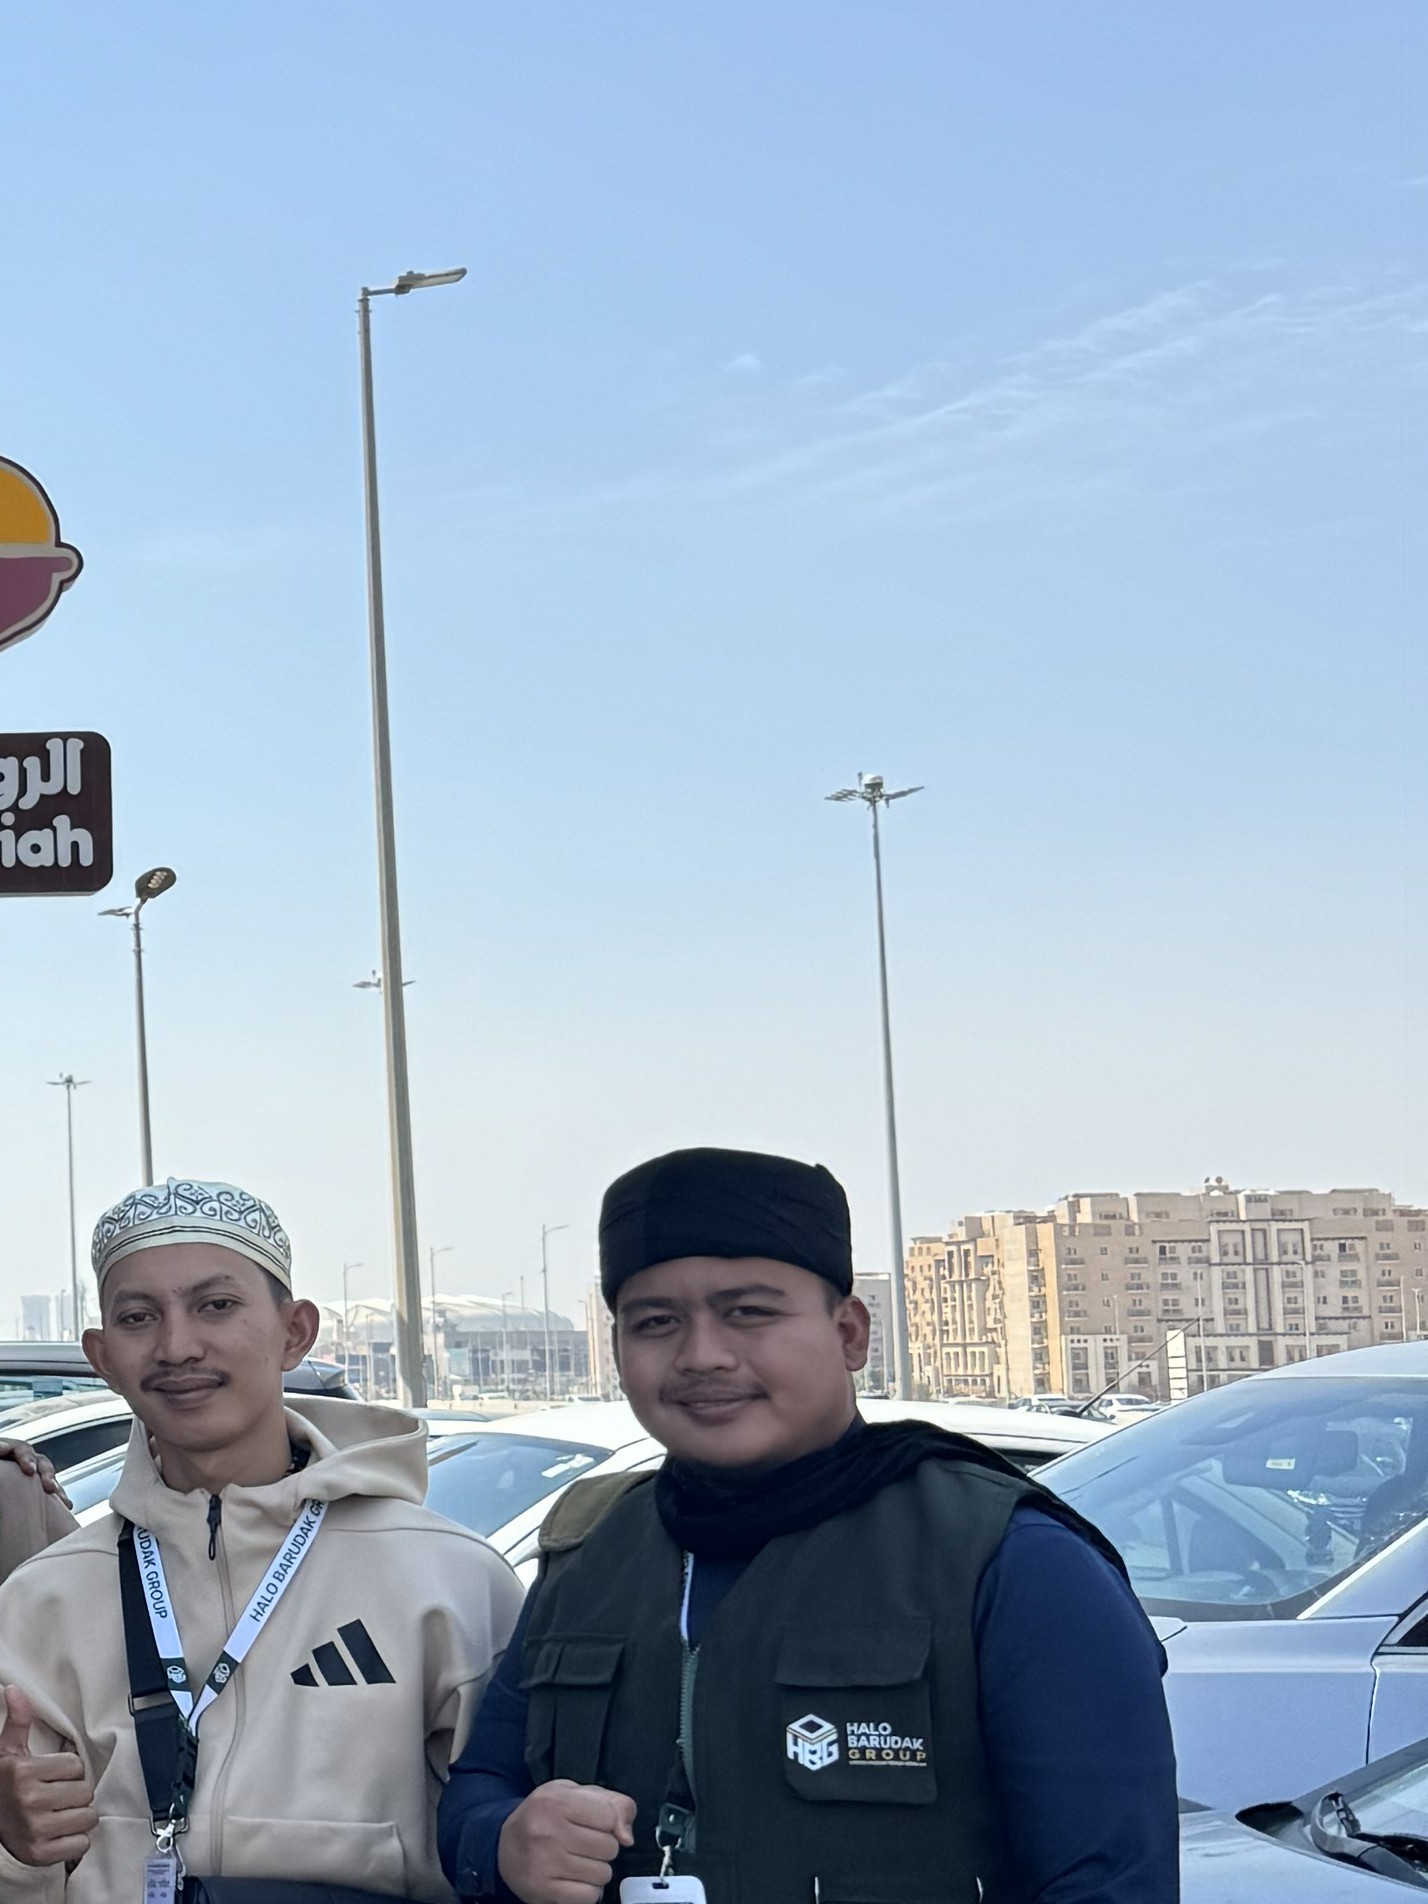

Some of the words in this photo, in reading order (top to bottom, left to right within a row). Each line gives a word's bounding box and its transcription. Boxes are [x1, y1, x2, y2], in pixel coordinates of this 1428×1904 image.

[249, 1582, 279, 1623] HALO
[271, 1513, 317, 1584] BARUDAK
[145, 1569, 169, 1619] GROUP
[846, 1722, 892, 1735] HALO
[847, 1735, 924, 1750] BARUDAK
[848, 1748, 926, 1761] GROUP
